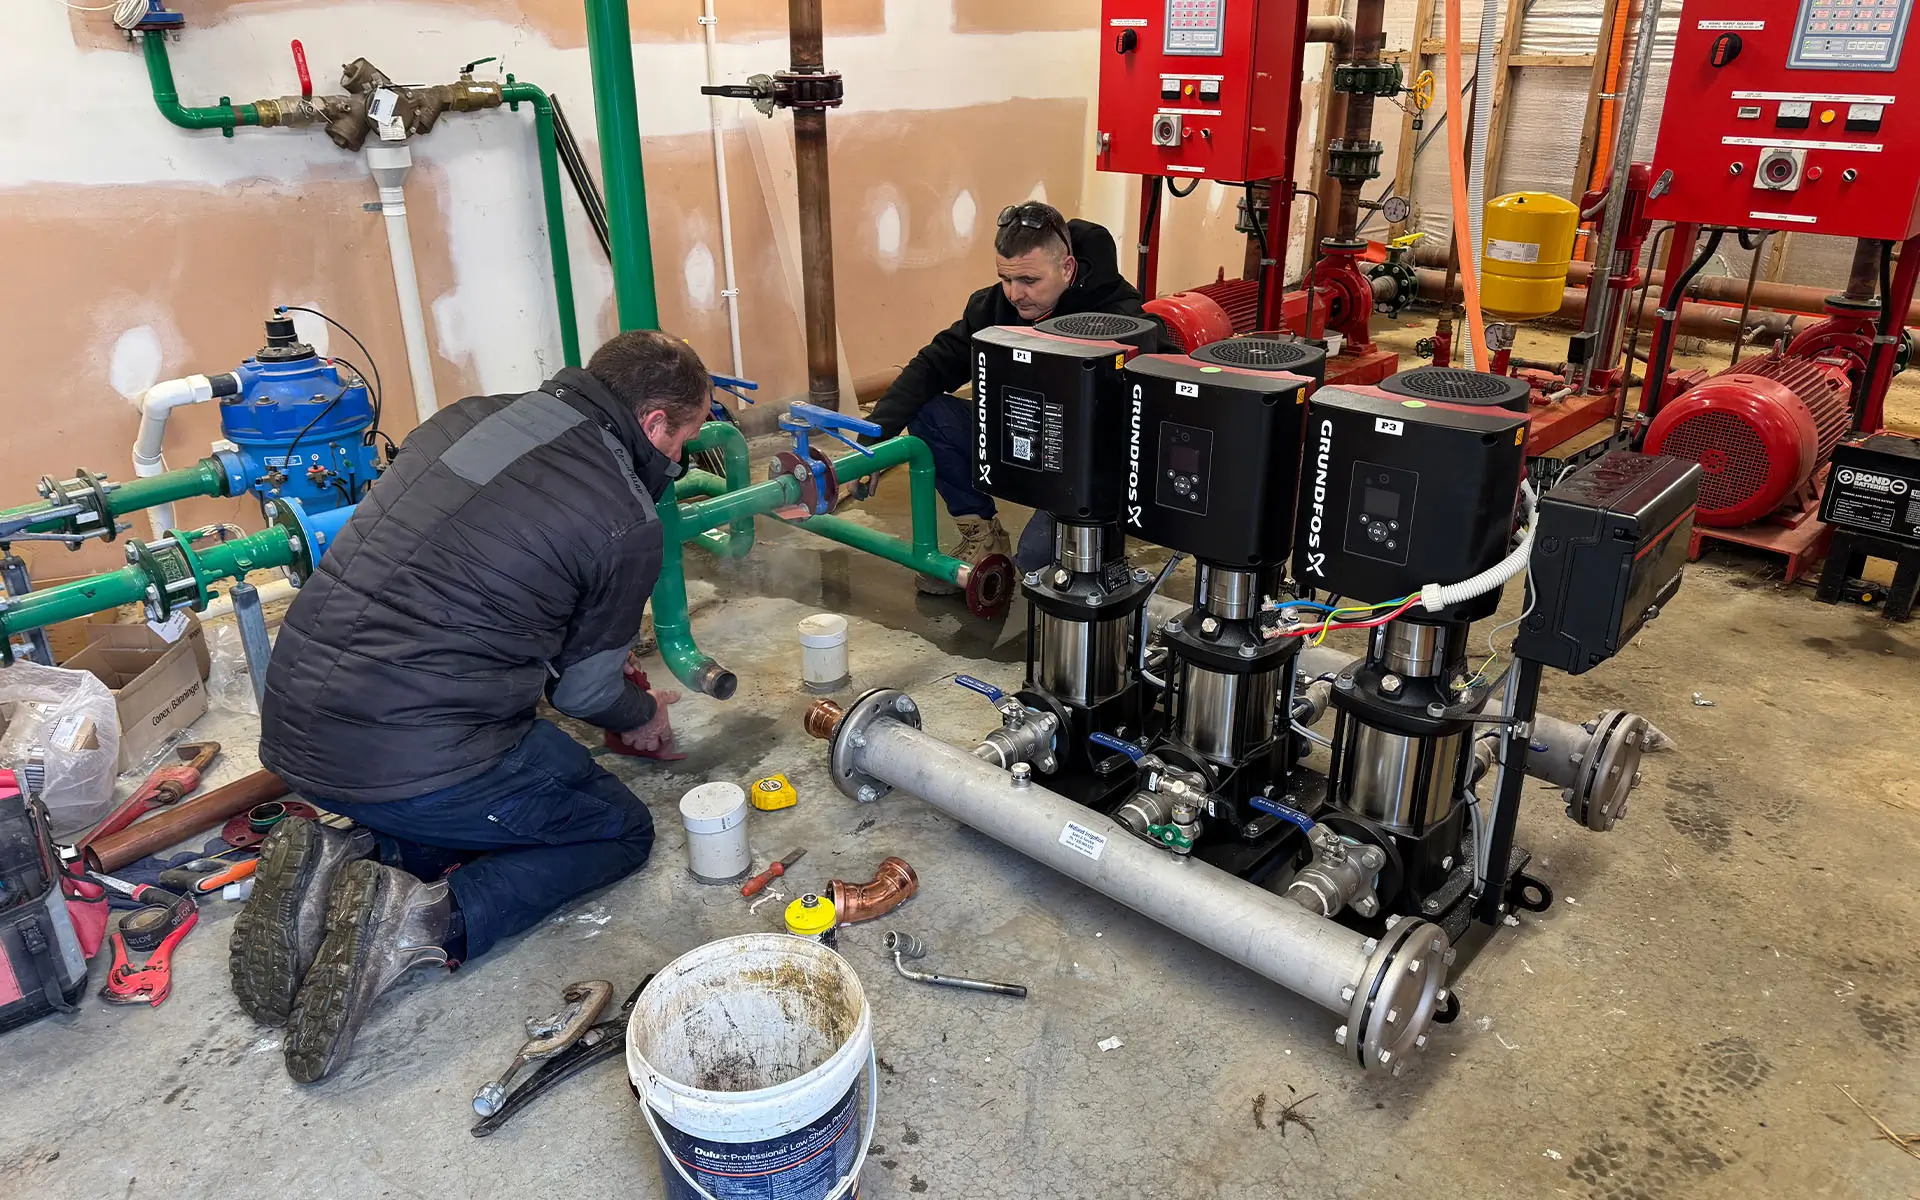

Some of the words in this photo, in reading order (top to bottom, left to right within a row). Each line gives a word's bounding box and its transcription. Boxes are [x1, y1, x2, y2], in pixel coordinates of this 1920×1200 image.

[1016, 352, 1027, 360] P1
[1180, 385, 1193, 394] P2
[978, 352, 987, 461] GRUNDFOS
[1381, 422, 1397, 432] P3
[1128, 383, 1142, 502] GRUNDFOS
[1308, 419, 1333, 549] GRUNDFOS
[1853, 480, 1890, 492] BATTERIES
[1855, 472, 1891, 486] BOND
[152, 707, 170, 726] Conex
[171, 680, 200, 710] Bänninger
[730, 1144, 788, 1161] Professional
[790, 1138, 809, 1151] Low
[808, 1123, 832, 1143] Sheen
